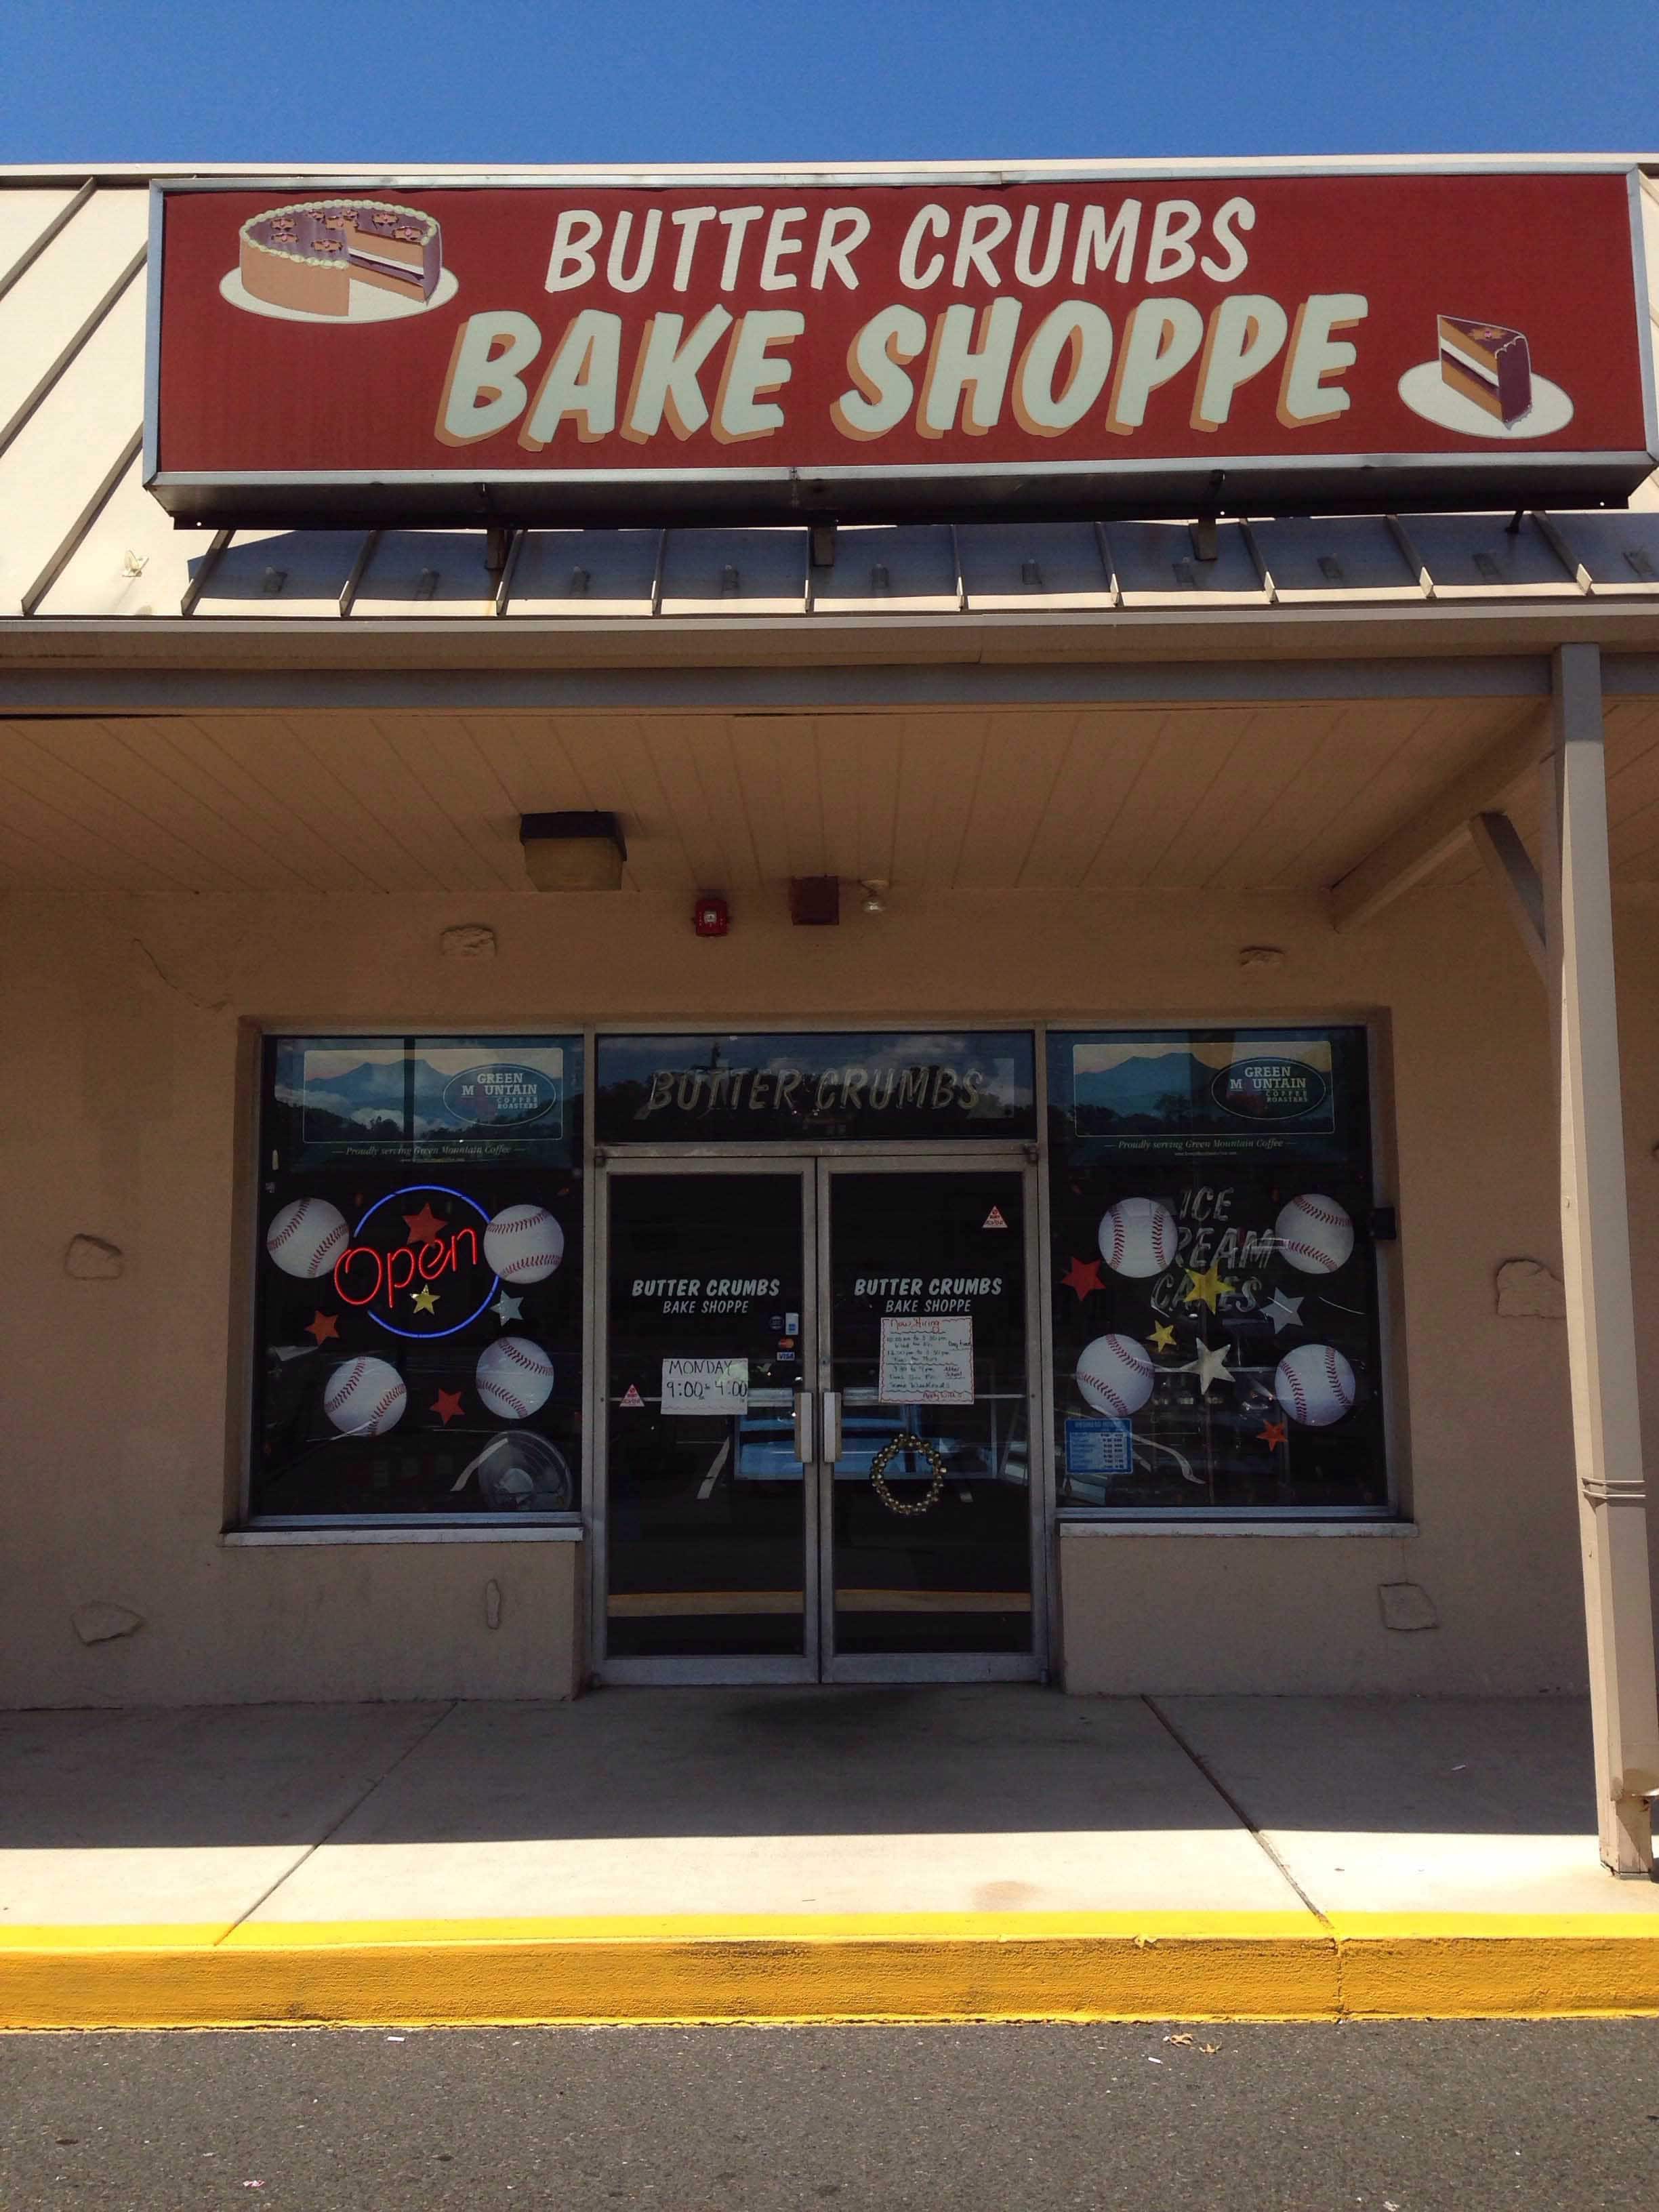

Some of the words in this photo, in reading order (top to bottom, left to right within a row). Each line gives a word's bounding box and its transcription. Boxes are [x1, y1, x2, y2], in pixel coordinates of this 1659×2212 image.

[544, 205, 871, 293] BUTTER
[899, 197, 1256, 290] CRUMBS
[434, 304, 805, 452] BAKE
[830, 293, 1368, 442] SHOPPE
[477, 1073, 523, 1084] GREEN
[1244, 1066, 1291, 1078] GREEN
[461, 1084, 537, 1096] MUNTAIN
[648, 1068, 804, 1111] BUTTER
[815, 1067, 984, 1111] CRUMBS
[1230, 1078, 1307, 1090] MUNTAIN
[345, 1146, 378, 1158] Proudly
[413, 1145, 439, 1155] Green
[442, 1145, 483, 1155] Mountain
[485, 1143, 511, 1155] Coffee
[1118, 1140, 1151, 1152] Proudly
[1153, 1142, 1183, 1151] serving
[1185, 1139, 1212, 1149] Green
[1214, 1139, 1254, 1149] Mountain
[1256, 1138, 1284, 1150] Coffee
[1180, 1186, 1235, 1221] ICE
[1174, 1227, 1275, 1269] REAM
[334, 1229, 477, 1308] Open
[632, 1279, 701, 1296] BUTTER
[706, 1279, 781, 1296] CRUMBS
[854, 1278, 923, 1296] BUTTER
[928, 1277, 1003, 1295] CRUMBS
[1150, 1273, 1263, 1313] CAES
[663, 1300, 697, 1314] BAKE
[701, 1300, 749, 1314] SHOPPE
[886, 1299, 919, 1313] BAKE
[924, 1298, 971, 1313] SHOPPE
[669, 1360, 732, 1375] MONDAY
[667, 1381, 703, 1398] 9:00
[716, 1380, 747, 1397] 4:00
